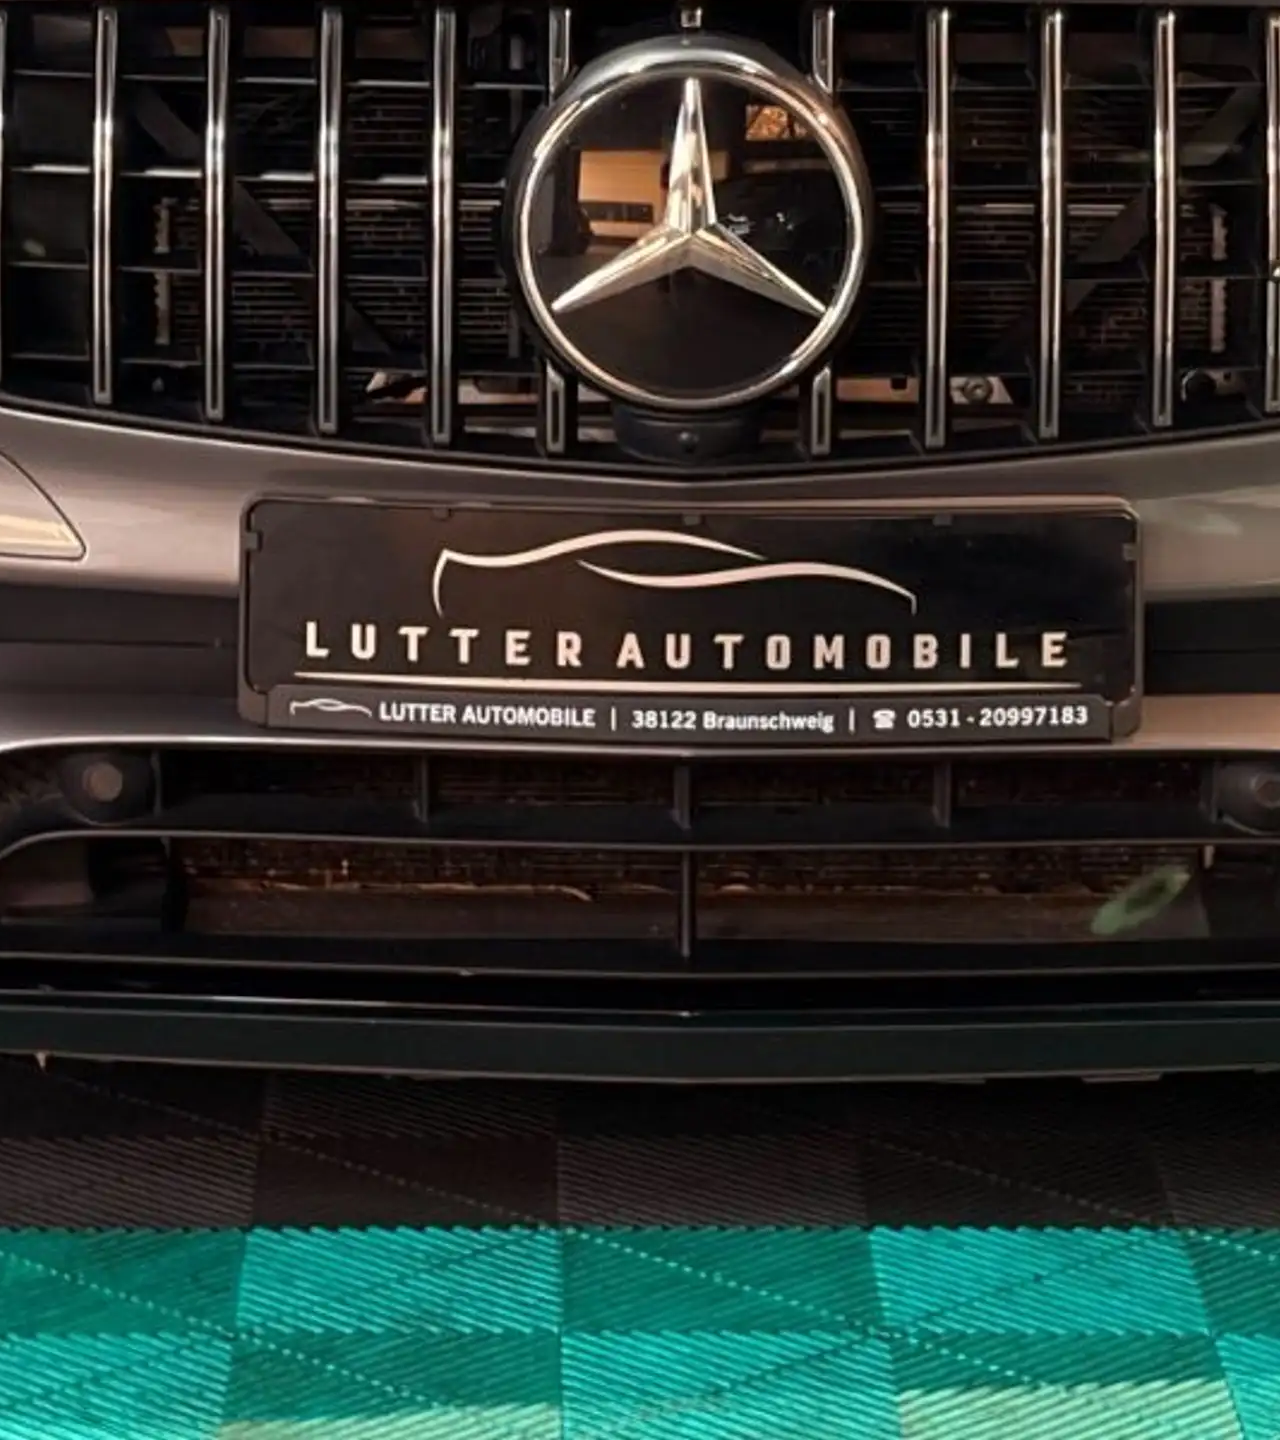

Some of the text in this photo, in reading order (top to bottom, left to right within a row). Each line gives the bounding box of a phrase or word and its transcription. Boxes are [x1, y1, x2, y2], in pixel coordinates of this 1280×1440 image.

[305, 620, 1070, 671] LUTTER AUTOMOBILE
[378, 702, 457, 724] LUTTER
[461, 704, 596, 729] AUTOMOBILE
[631, 709, 697, 730] 38122
[702, 709, 835, 734] Braunschweig
[907, 707, 961, 729] 0531
[979, 705, 1090, 727] 20997183
